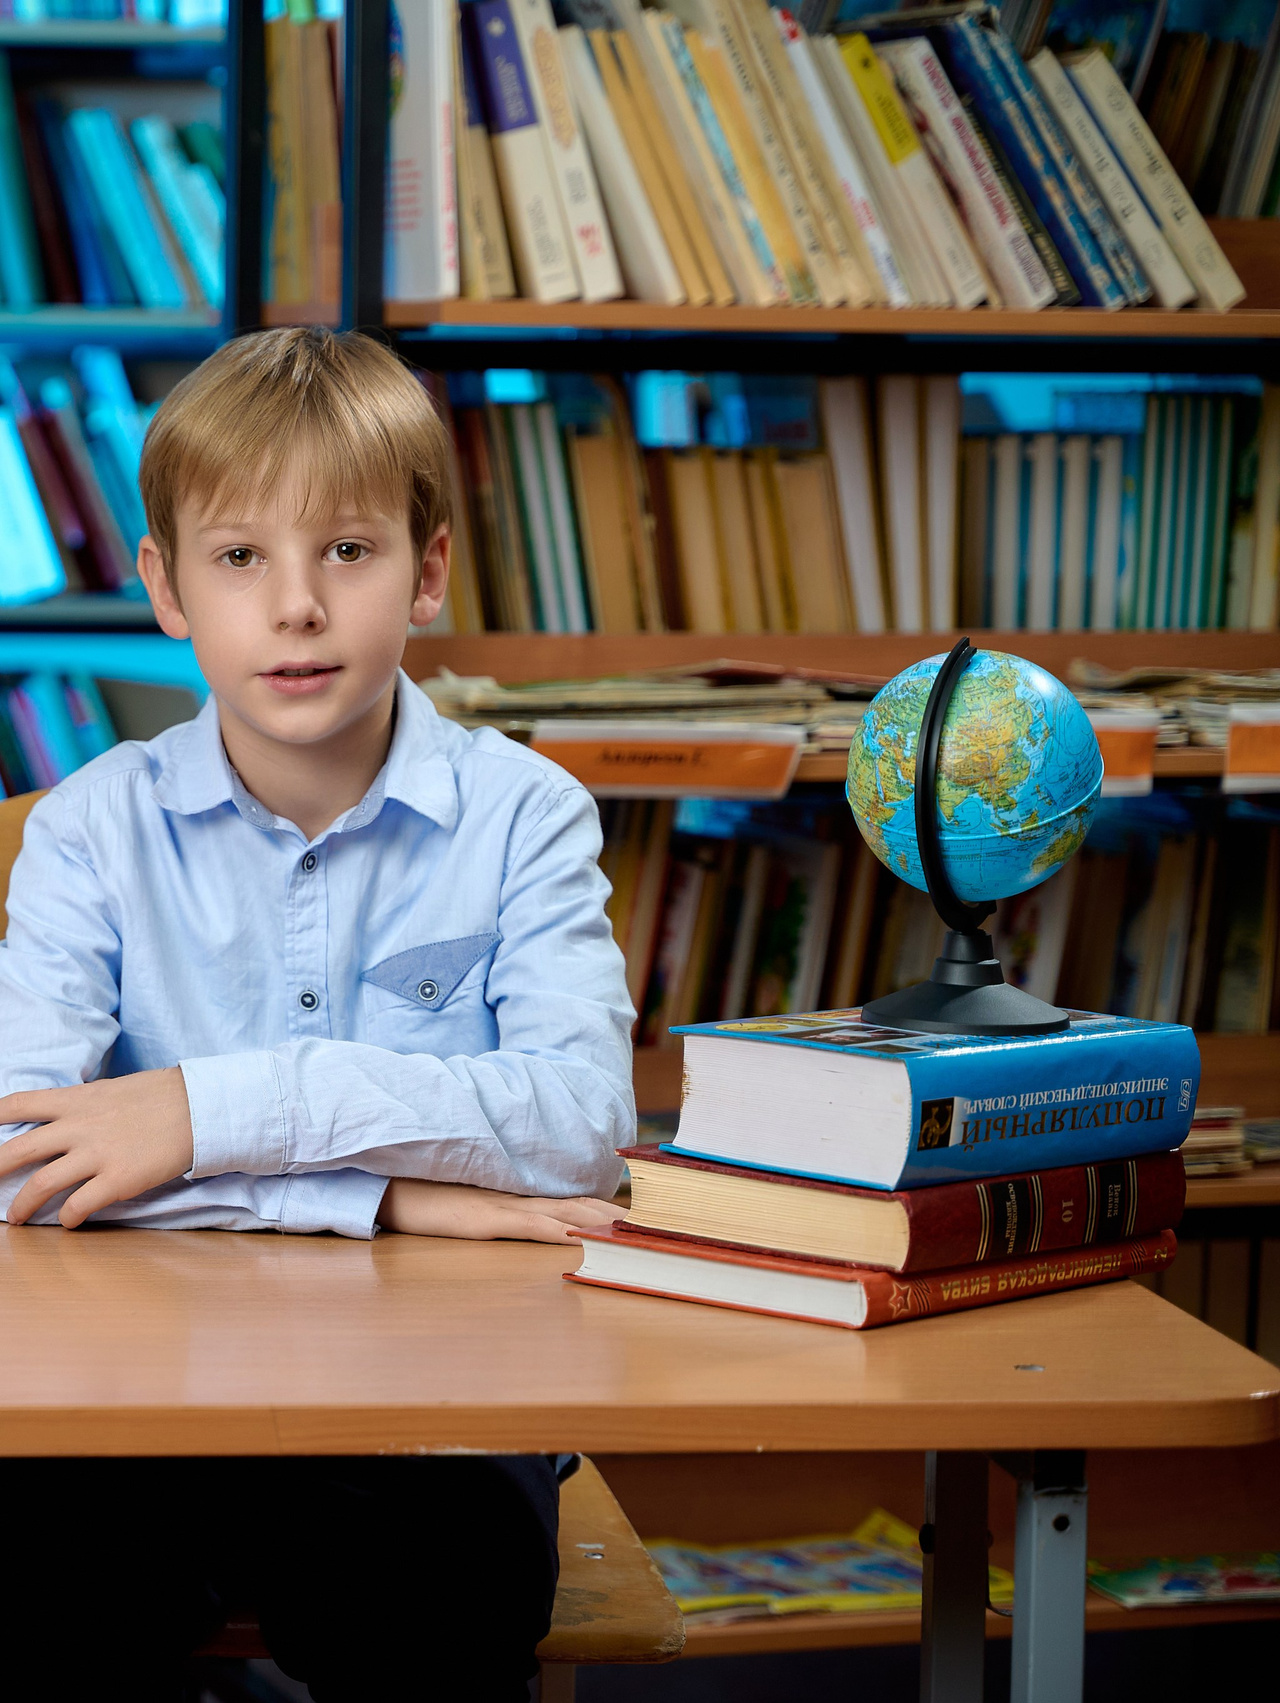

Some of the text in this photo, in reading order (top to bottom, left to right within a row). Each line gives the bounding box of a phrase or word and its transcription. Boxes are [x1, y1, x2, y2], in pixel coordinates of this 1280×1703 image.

[963, 1094, 1018, 1115] СЛОВАРЬ
[1019, 1077, 1169, 1111] ЭНЦИКЛОПЕДИЧЕСКИЙ
[959, 1096, 1167, 1152] ПОПУЛЯРНЫЙ
[1061, 1199, 1074, 1223] 10
[940, 1252, 1123, 1301] ЛЕНИНГРАДСКАЯ БИТВА
